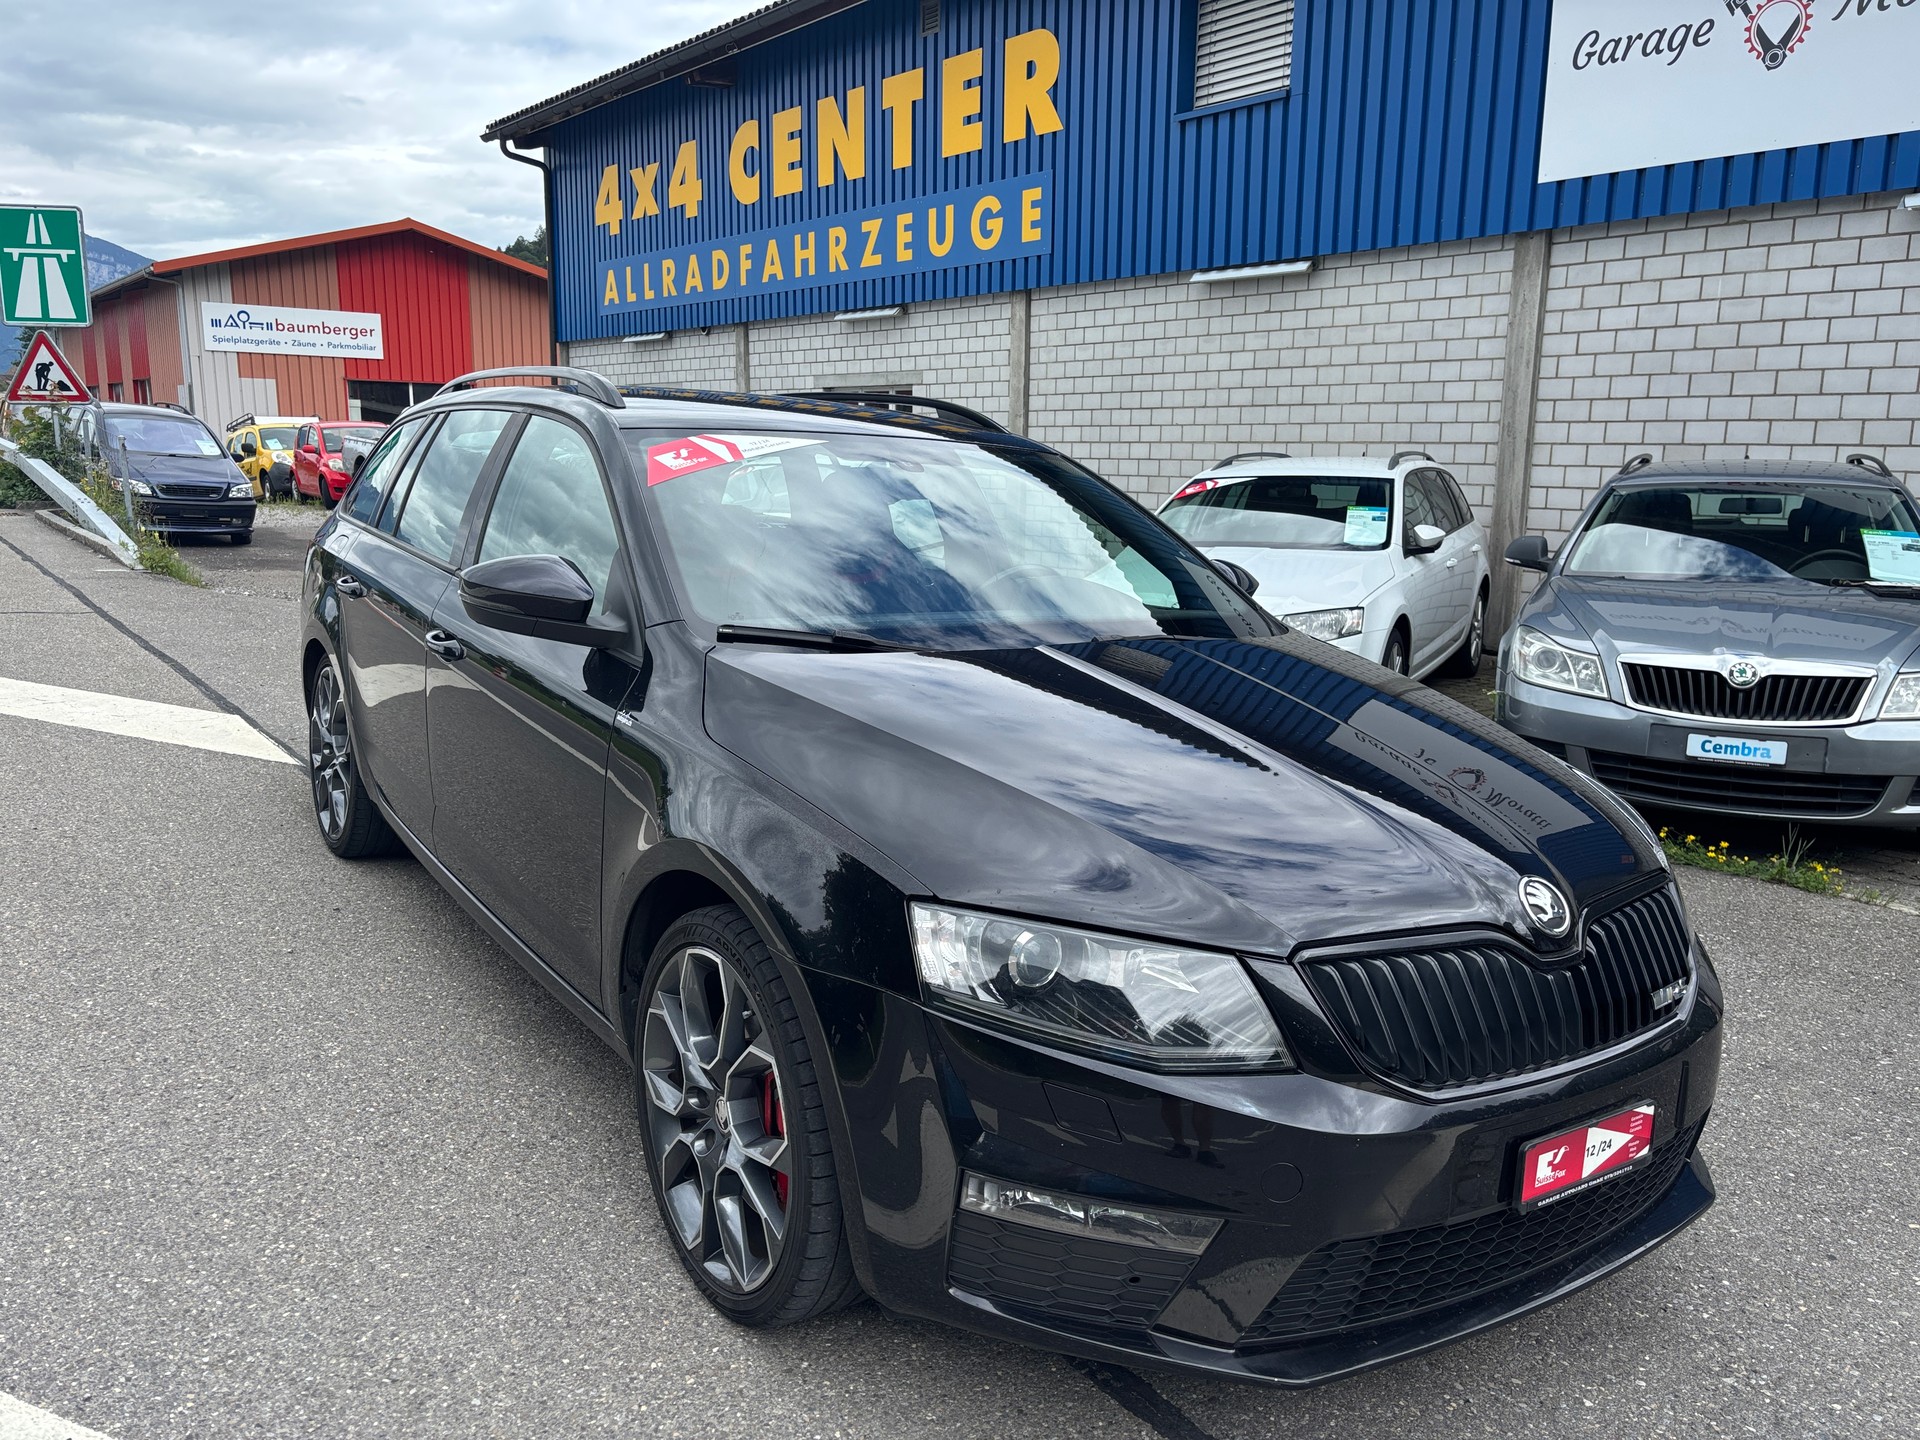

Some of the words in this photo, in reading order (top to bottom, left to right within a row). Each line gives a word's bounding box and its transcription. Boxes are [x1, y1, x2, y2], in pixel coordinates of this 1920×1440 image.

[1571, 18, 1715, 71] Garage
[595, 139, 702, 236] 4x4
[729, 28, 1064, 206] CENTER
[603, 187, 1042, 306] ALLRADFAHRZEUGE
[212, 335, 281, 346] Spielplatzgeräte
[291, 339, 317, 348] Zäune
[327, 341, 377, 352] Parkmobiliar
[274, 318, 376, 340] baumberger
[1700, 739, 1772, 759] Cembra
